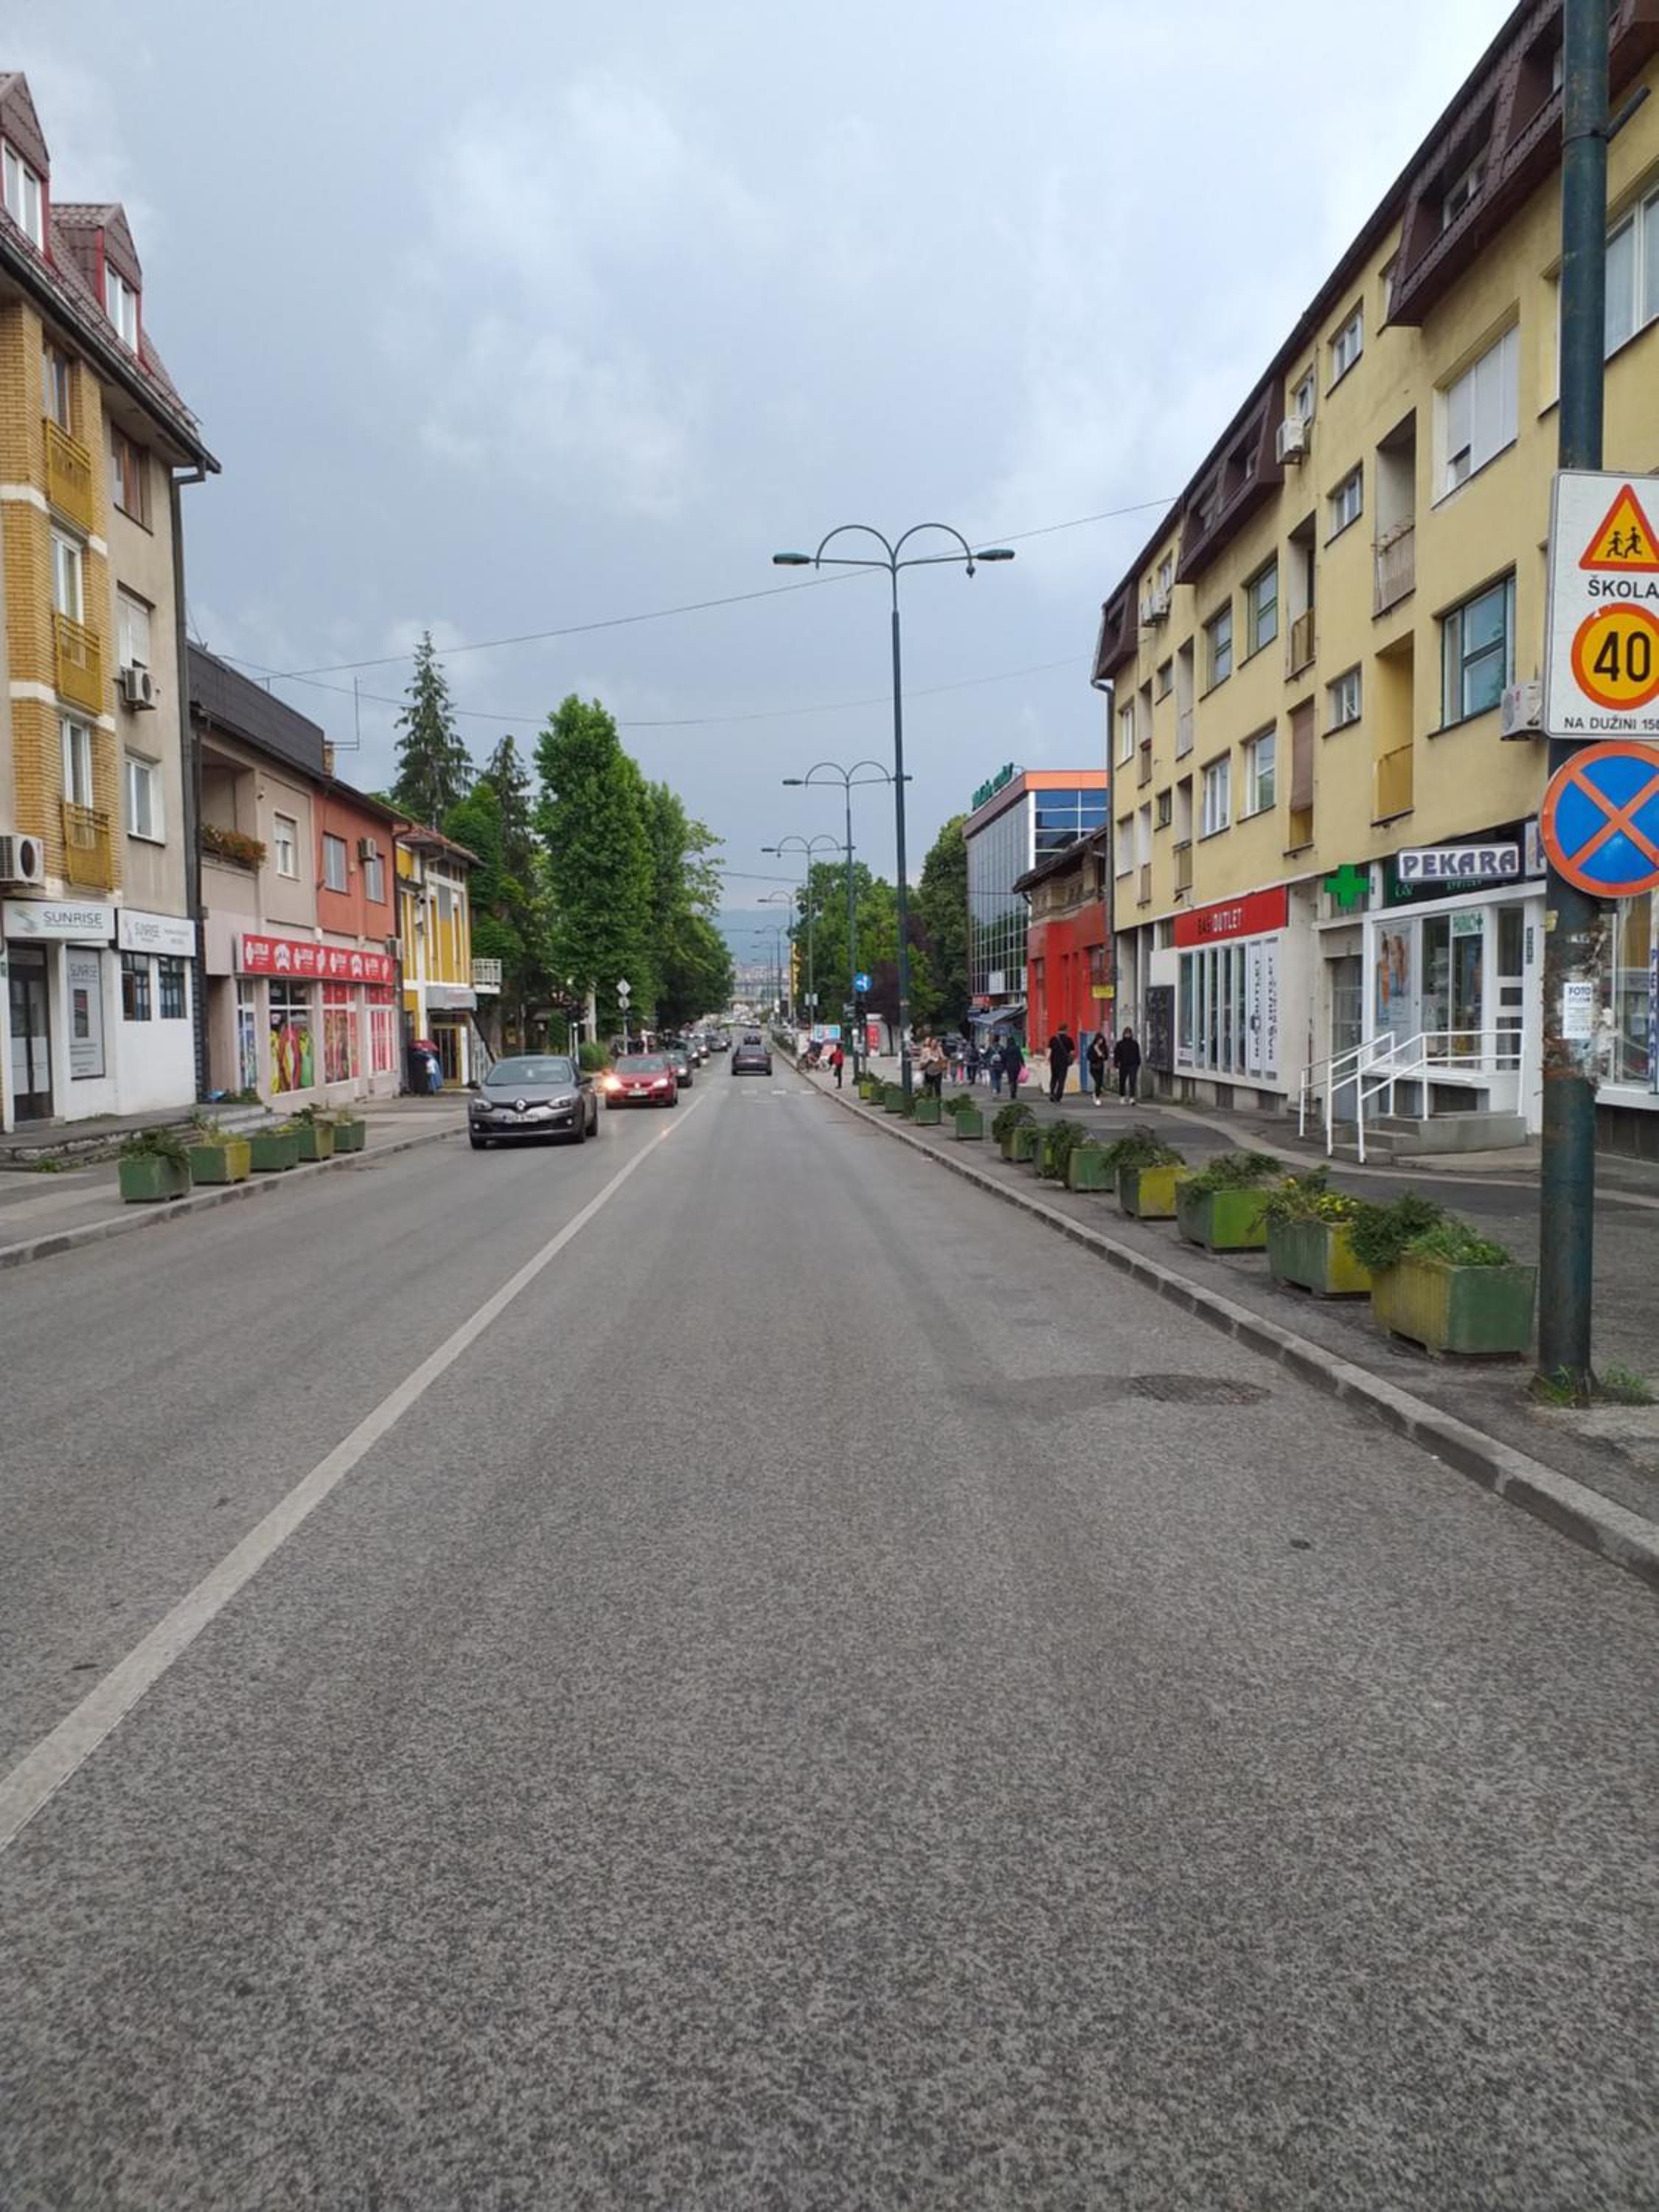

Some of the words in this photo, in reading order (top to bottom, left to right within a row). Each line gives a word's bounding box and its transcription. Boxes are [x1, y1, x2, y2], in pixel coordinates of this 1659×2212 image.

[1587, 575, 1659, 599] ŠKOLA
[1593, 631, 1651, 682] 40
[1564, 717, 1585, 729] NA
[1590, 714, 1637, 730] DUŽINI
[1402, 849, 1516, 877] PEKARA
[43, 911, 102, 924] SUNRISE
[1568, 987, 1591, 995] FOTO
